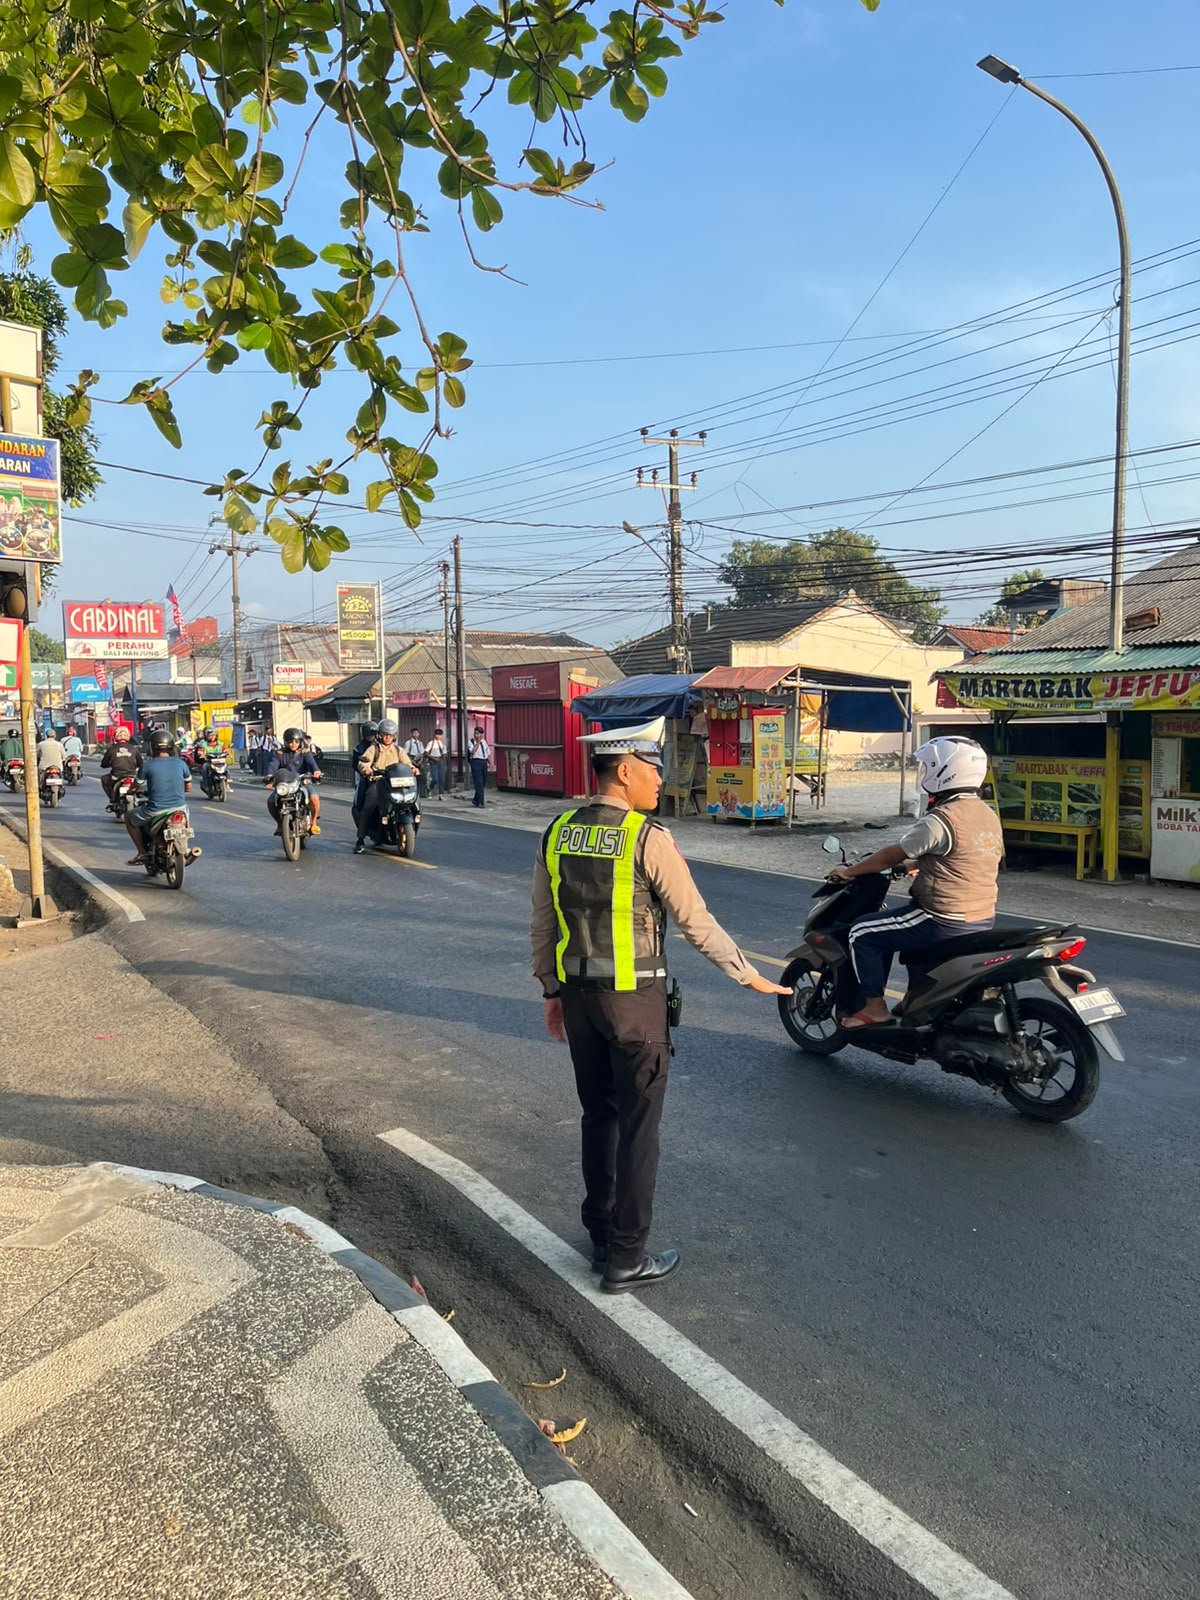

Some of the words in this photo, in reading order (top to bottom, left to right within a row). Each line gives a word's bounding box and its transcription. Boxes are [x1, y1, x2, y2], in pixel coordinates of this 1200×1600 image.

[70, 607, 159, 634] CARDINAL
[107, 641, 154, 650] PERAHU
[958, 678, 1094, 698] MARTABAK
[1015, 762, 1068, 775] MARTABAK
[1071, 766, 1106, 777] "JEFF
[1156, 806, 1197, 823] Milk
[1156, 822, 1183, 831] BOBA
[1186, 824, 1200, 832] TA
[556, 825, 626, 856] POLISI
